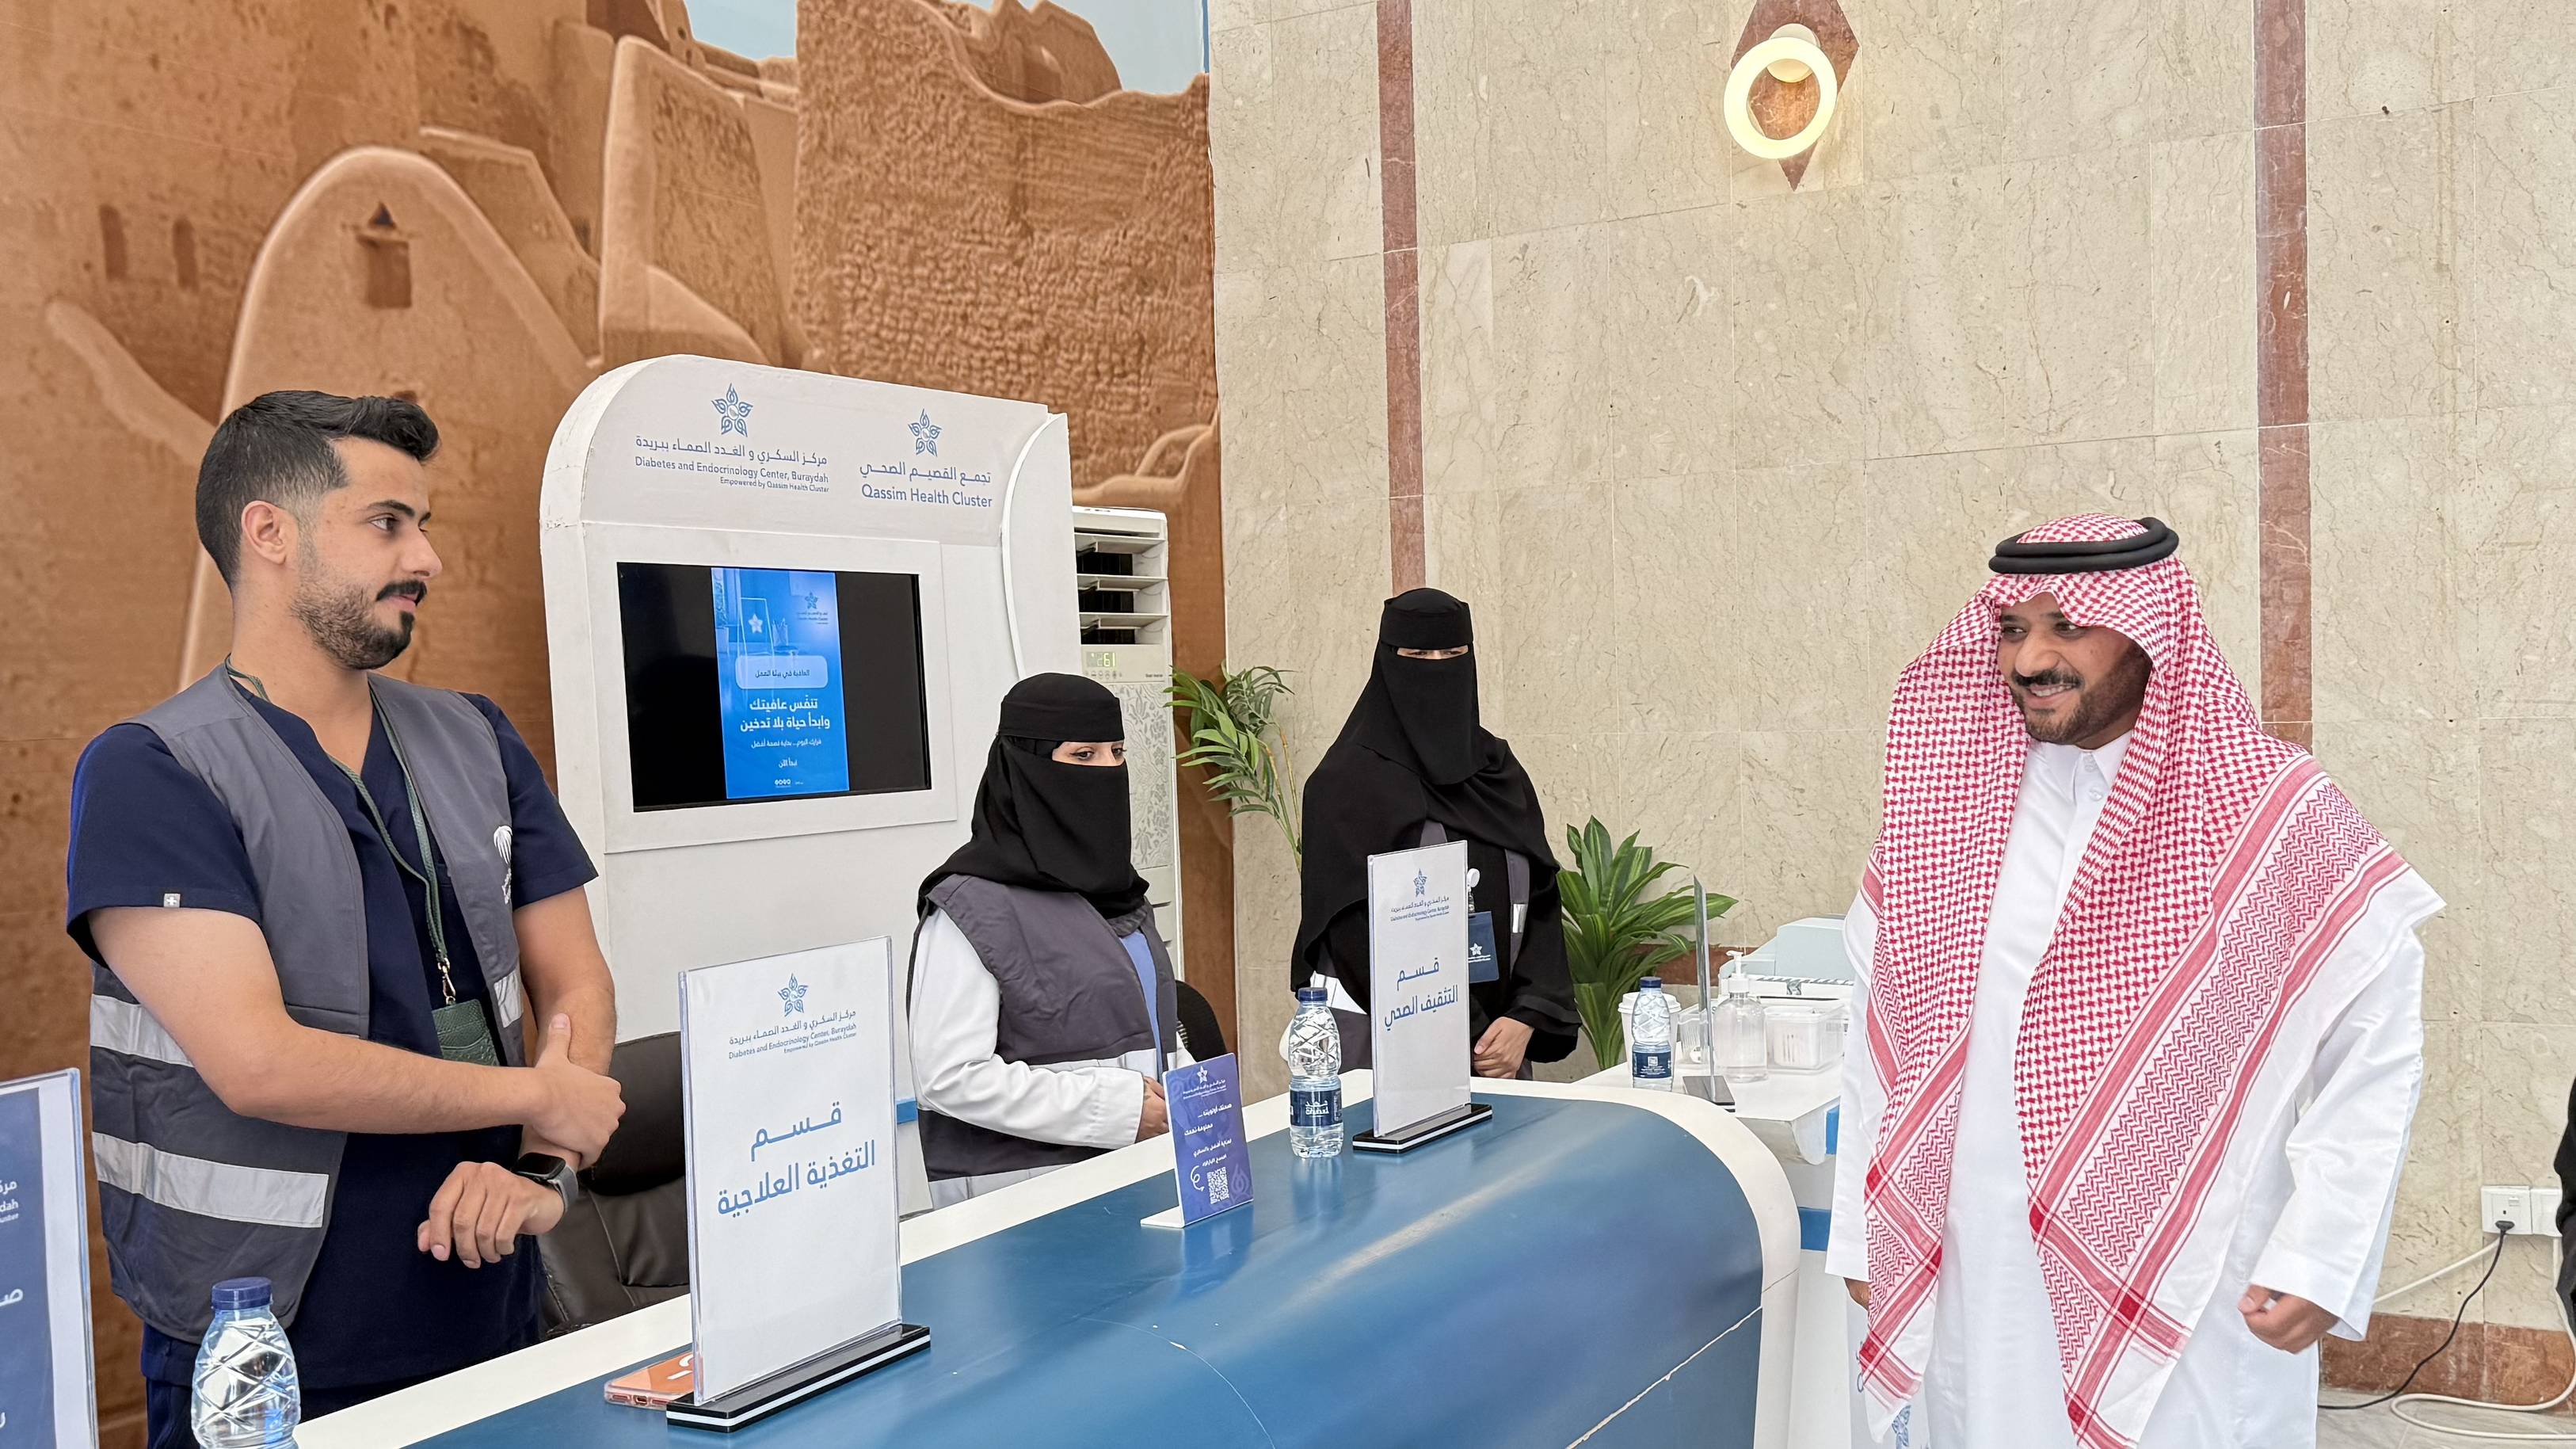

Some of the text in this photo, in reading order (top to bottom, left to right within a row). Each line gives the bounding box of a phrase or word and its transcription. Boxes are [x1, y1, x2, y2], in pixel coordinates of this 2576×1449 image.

[635, 435, 827, 467] مركز السكري و الغدد الصماء ببريدة
[635, 456, 829, 483] Diabetes and Endocrinology Center, Buraydah
[859, 462, 991, 486] تجمع القصيم الصحي
[720, 476, 756, 487] Empowered
[758, 480, 766, 489] by
[790, 482, 808, 491] Health
[862, 484, 993, 507] Qassim Health Cluster
[749, 698, 787, 712] عافيتك
[741, 711, 830, 732] وابدأ حياة بلا تدخين
[1397, 957, 1439, 991] قسم
[1384, 984, 1458, 1031] التثقيف الصحي
[751, 1101, 842, 1161] قسم
[718, 1139, 875, 1218] التغذية العلاجية
